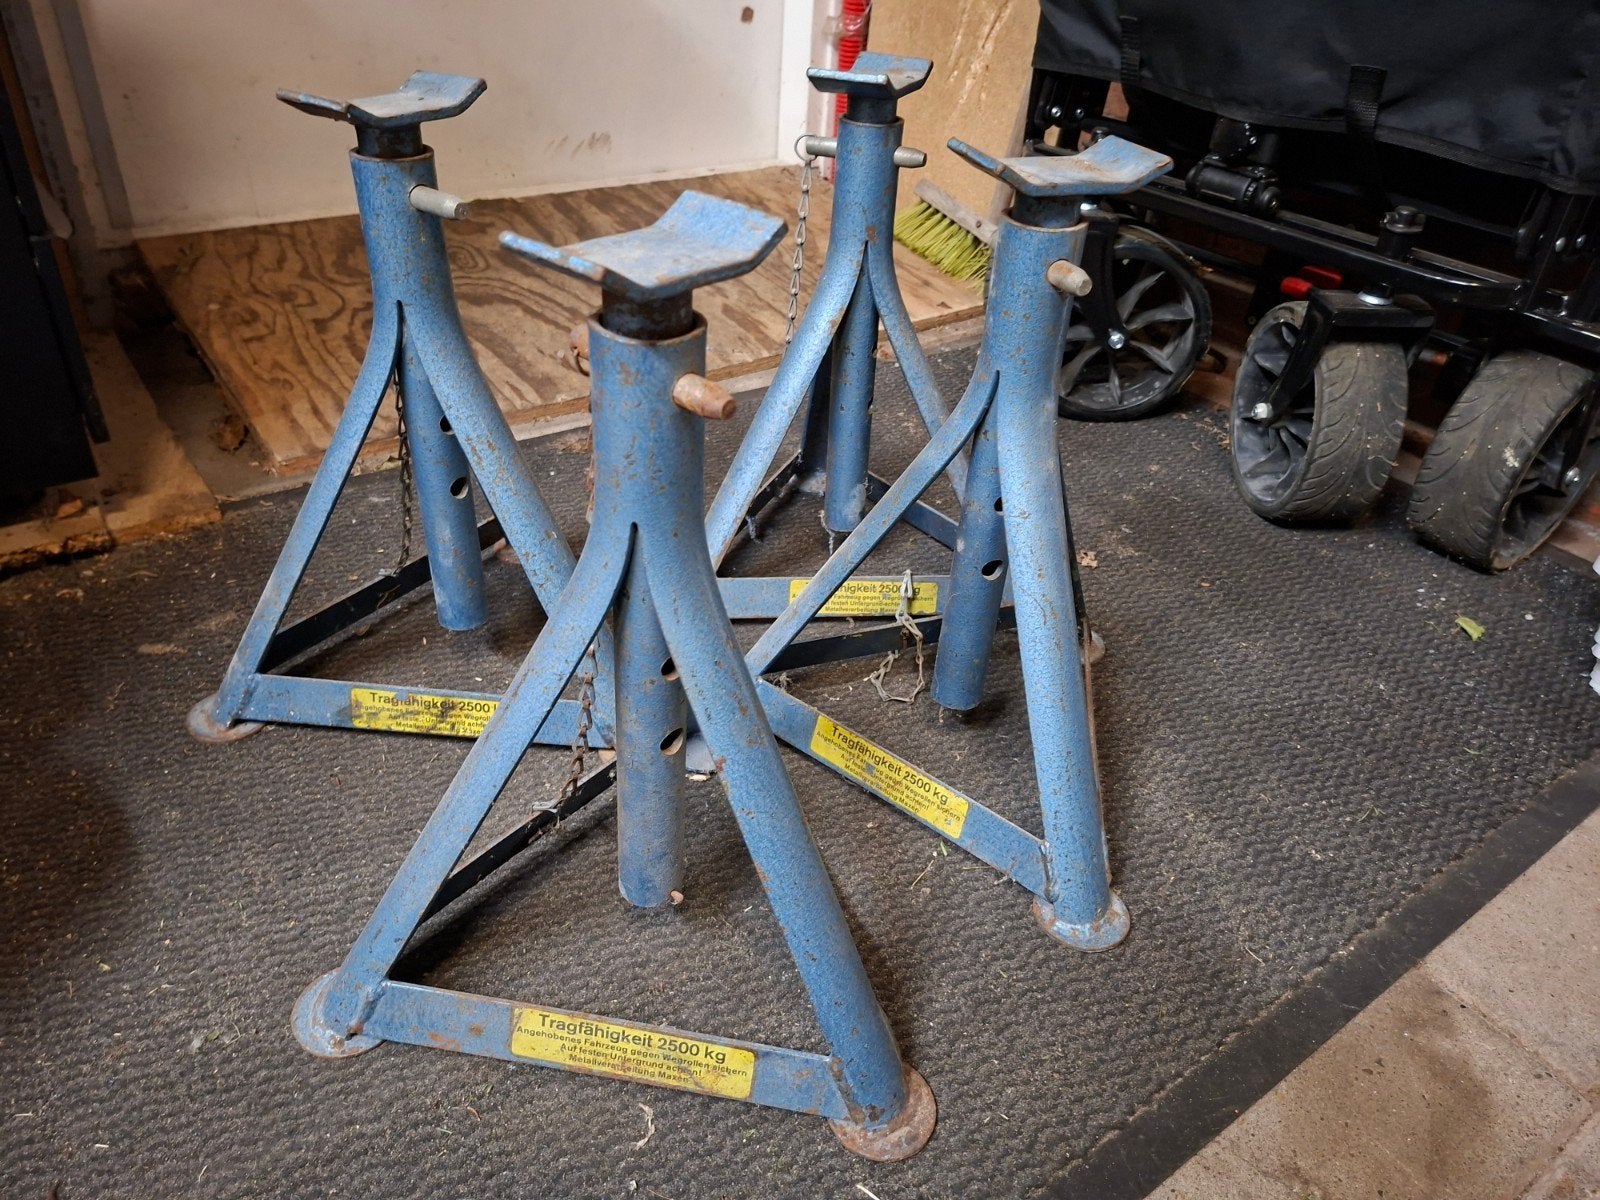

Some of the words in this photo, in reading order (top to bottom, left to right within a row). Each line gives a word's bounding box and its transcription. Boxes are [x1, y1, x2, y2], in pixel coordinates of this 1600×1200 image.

[459, 700, 490, 713] 2500
[464, 713, 491, 722] Wegroll
[832, 725, 903, 776] Tragfähigkeit
[903, 771, 931, 793] 2500
[933, 787, 949, 805] kg
[516, 1025, 582, 1045] Angehobenes
[584, 1038, 628, 1055] Fahrzeug
[630, 1048, 660, 1059] gegen
[539, 1013, 653, 1048] Tragfähigkeit
[656, 1037, 700, 1057] 2500
[704, 1046, 727, 1064] kg
[560, 1042, 577, 1053] Auf
[610, 1051, 664, 1069] Untergrund
